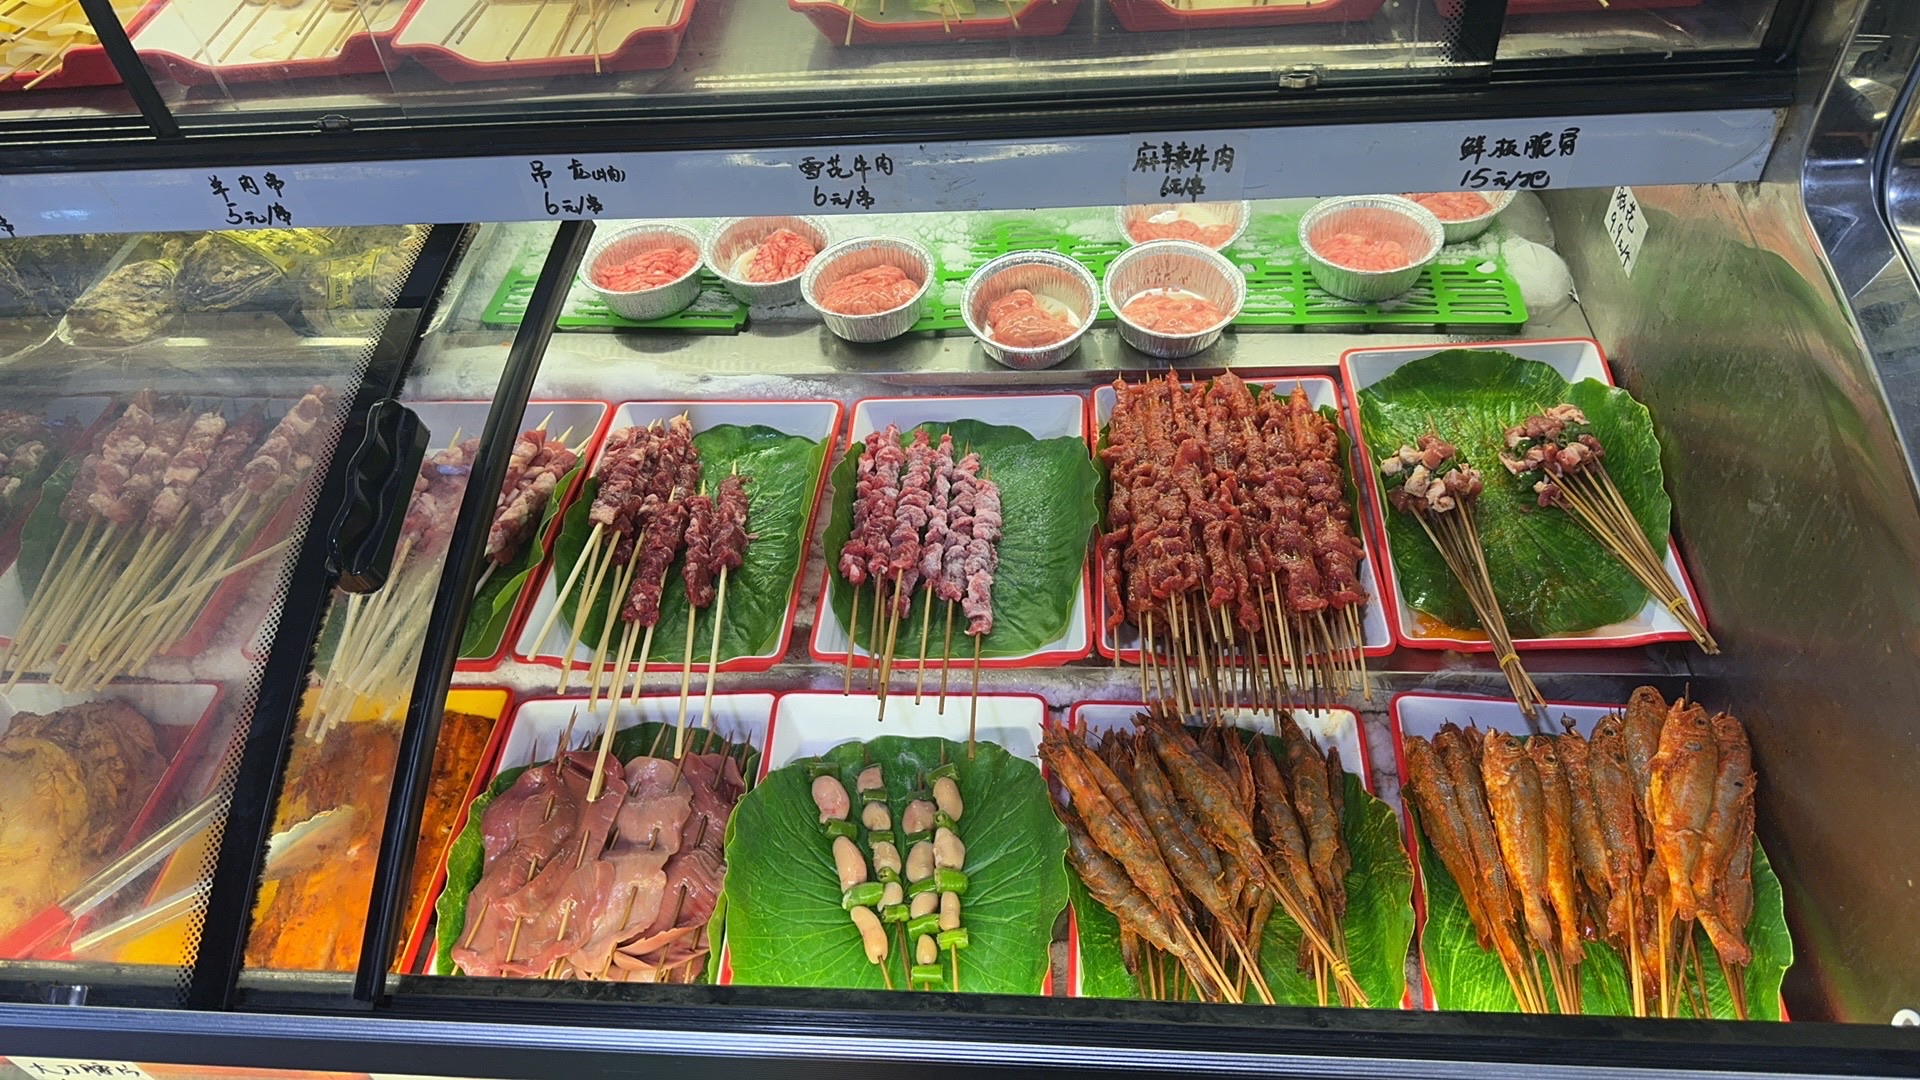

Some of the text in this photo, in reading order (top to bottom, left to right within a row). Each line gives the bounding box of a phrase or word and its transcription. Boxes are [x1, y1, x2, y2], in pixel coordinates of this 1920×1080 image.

[798, 153, 894, 183] 雪花牛肉
[1132, 141, 1235, 174] 麻辣牛肉
[207, 171, 285, 203] 羊肉串
[1460, 168, 1550, 190] 15元/把
[545, 191, 604, 215] 6元/串
[814, 185, 875, 210] 6元/串
[226, 201, 292, 226] 5元/串
